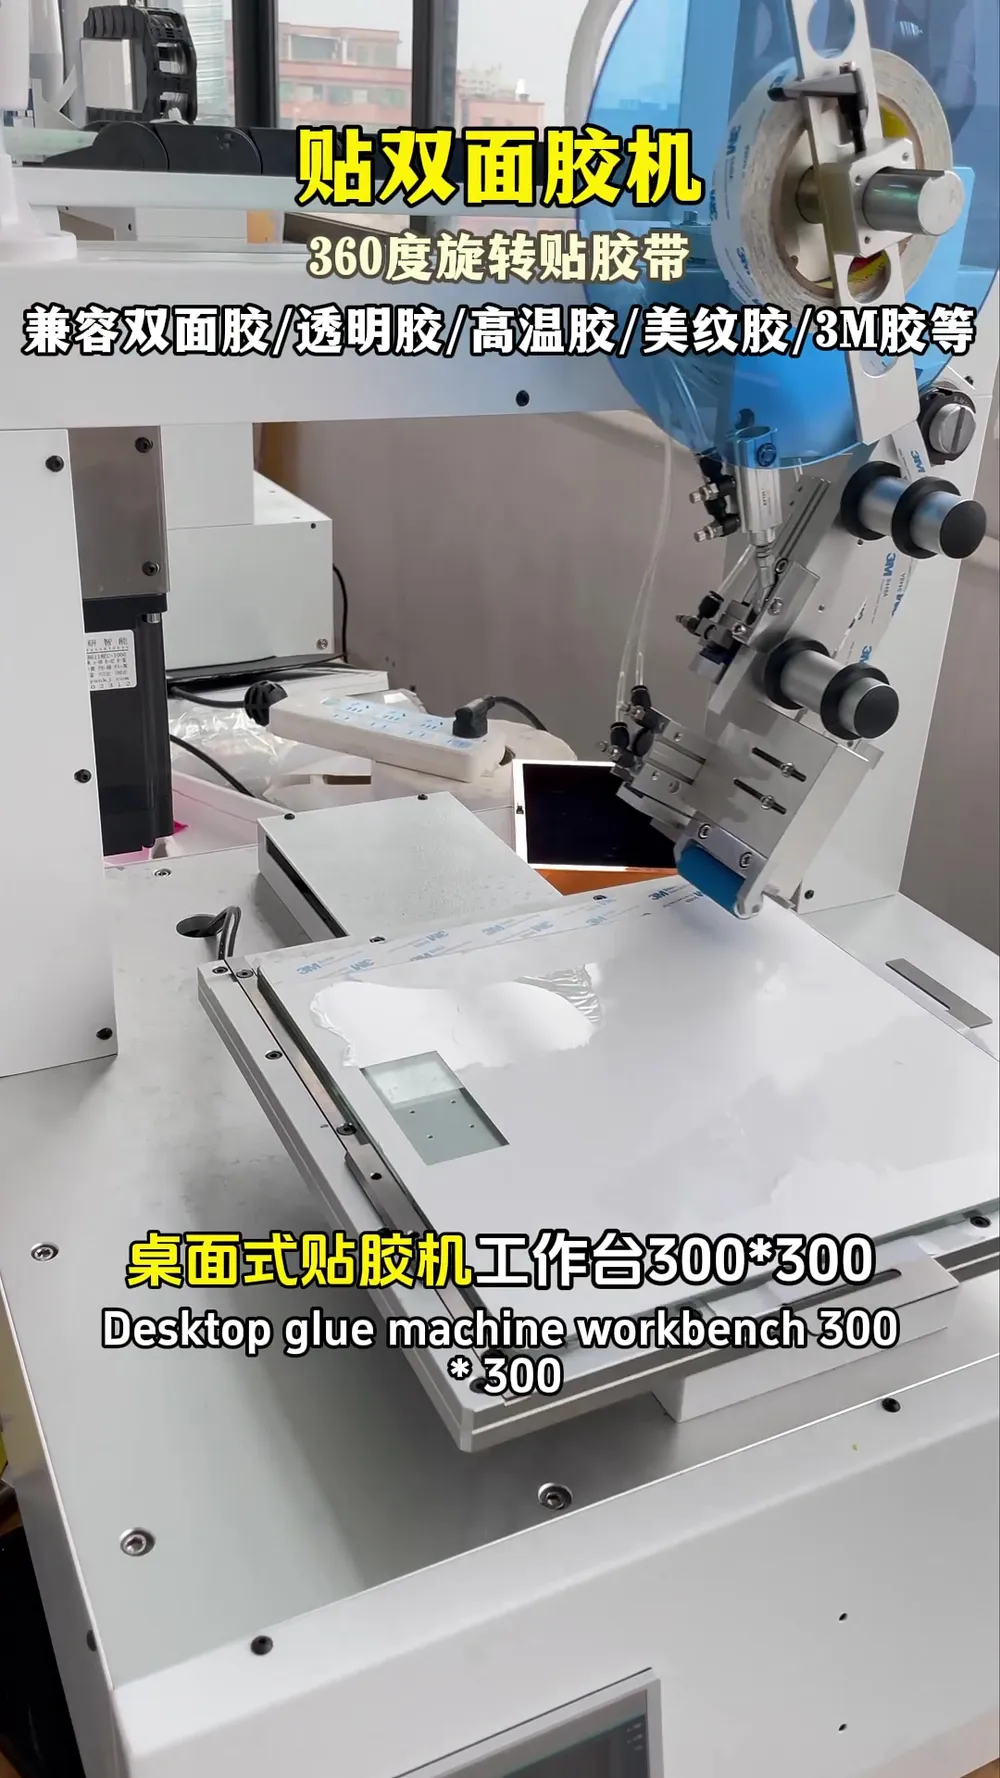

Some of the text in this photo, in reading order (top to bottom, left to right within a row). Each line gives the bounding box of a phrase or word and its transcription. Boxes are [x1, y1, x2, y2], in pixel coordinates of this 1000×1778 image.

[909, 449, 926, 473] 3M
[883, 552, 896, 577] 3M
[648, 888, 670, 901] 3M
[296, 962, 322, 975] 3M
[350, 958, 375, 972] 3M
